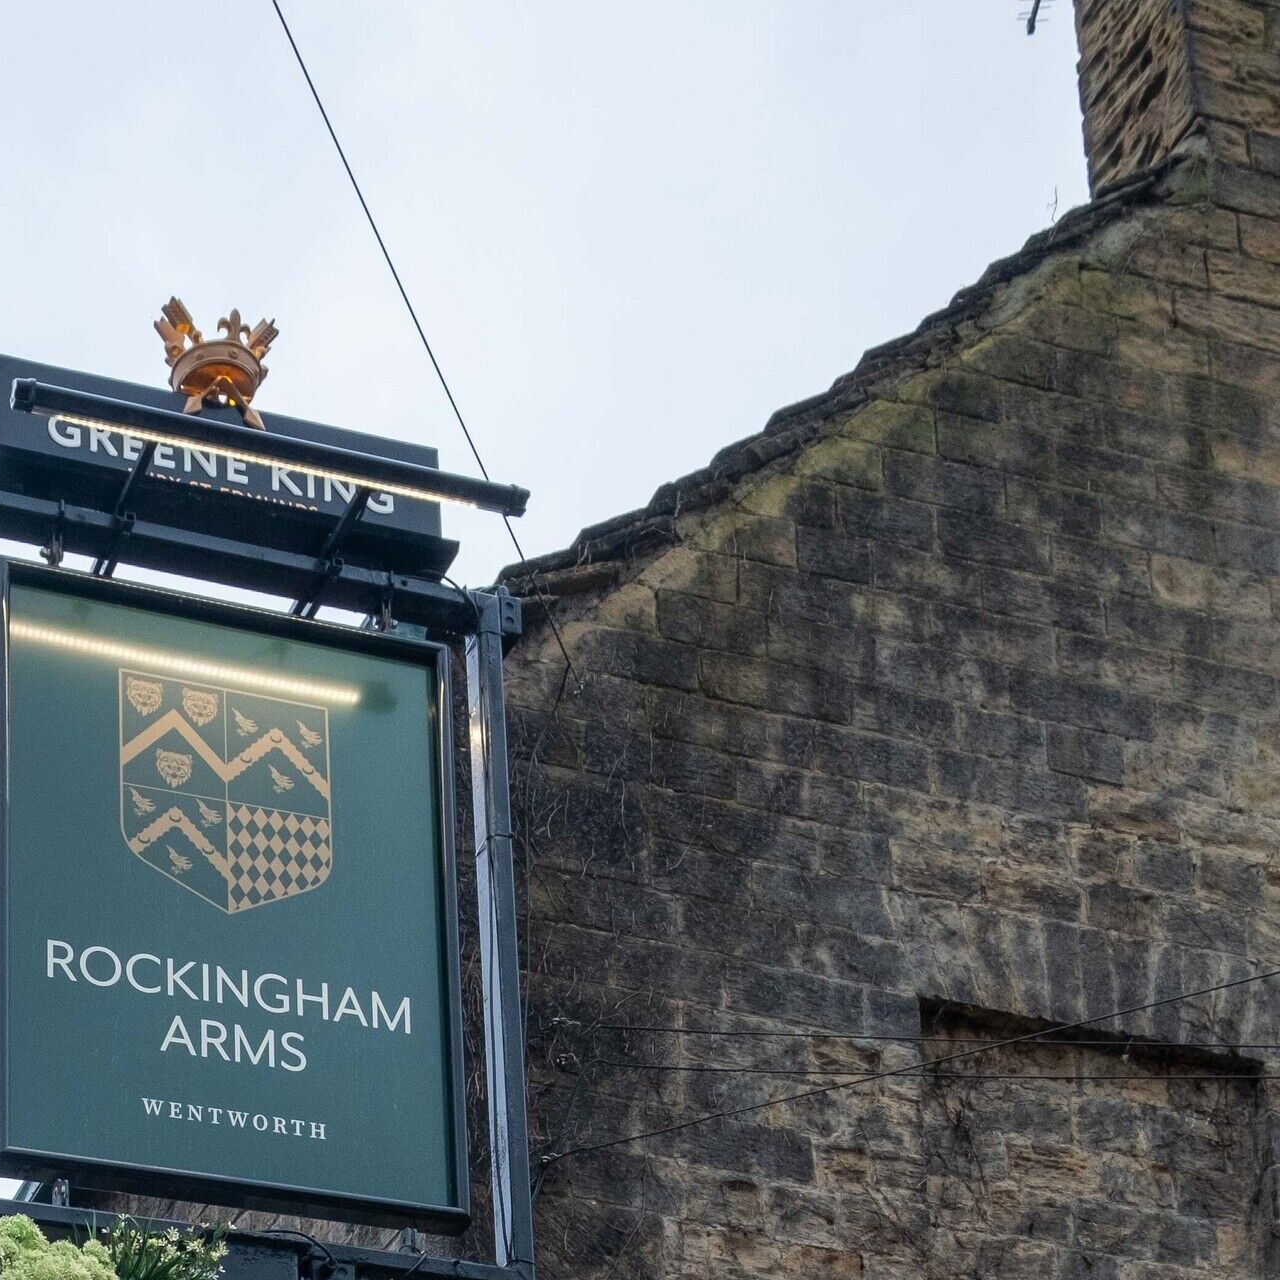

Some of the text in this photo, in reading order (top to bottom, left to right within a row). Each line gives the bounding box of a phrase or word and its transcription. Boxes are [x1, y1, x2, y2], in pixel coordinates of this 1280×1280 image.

[47, 416, 249, 485] GREENE
[271, 464, 395, 515] KING
[46, 938, 413, 1035] ROCKINGHAM
[159, 1014, 308, 1073] ARMS
[141, 1097, 328, 1141] WENTWORTH
